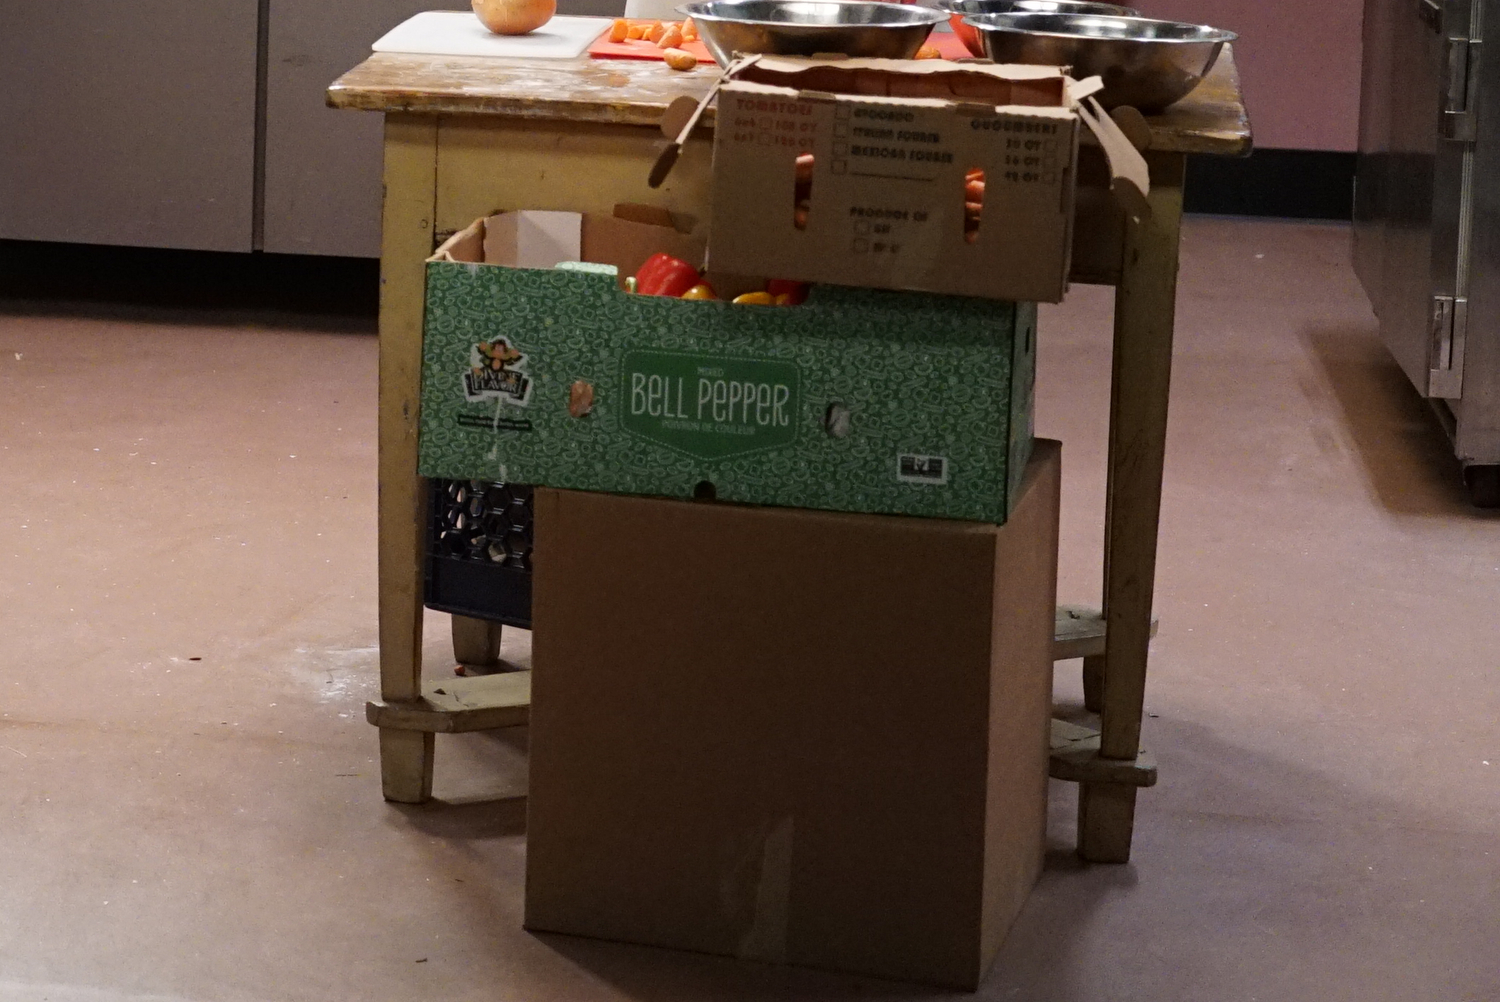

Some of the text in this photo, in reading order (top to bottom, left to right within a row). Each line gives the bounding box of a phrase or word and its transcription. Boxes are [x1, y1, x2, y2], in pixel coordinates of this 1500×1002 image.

[736, 99, 813, 115] TOMATOES
[697, 367, 725, 378] MIXED
[474, 379, 518, 394] FLAVOR
